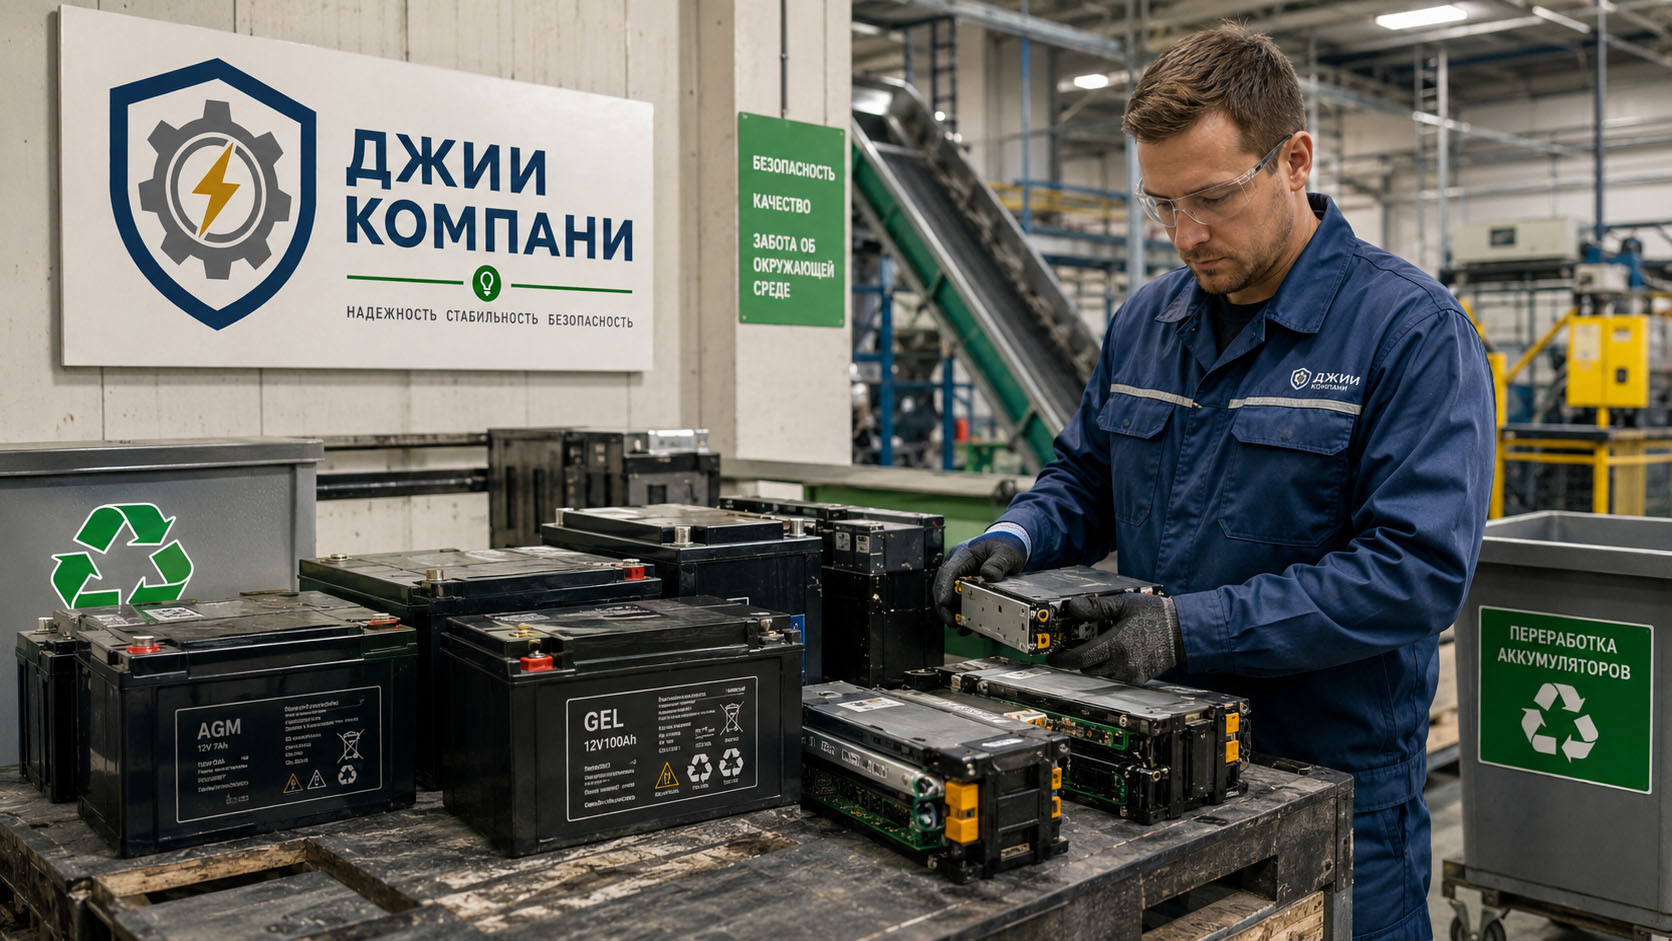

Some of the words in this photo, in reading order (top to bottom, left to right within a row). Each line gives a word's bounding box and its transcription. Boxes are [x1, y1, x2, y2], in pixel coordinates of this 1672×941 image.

[346, 128, 546, 197] ДЖИИ
[752, 155, 836, 181] БЕЗОПАСНОСТЬ
[752, 193, 811, 214] КАЧЕСТВО
[346, 195, 633, 262] КОМПАНИ
[753, 233, 798, 252] ЗАБОТА
[800, 237, 816, 254] ОБ
[753, 257, 835, 280] ОКРУЖАЮЩЕЙ
[753, 280, 791, 299] СРЕДЕ
[346, 306, 437, 321] НАДЕЖНОСТЬ
[446, 309, 539, 325] СТАБИЛЬНОСТЬ
[548, 313, 634, 328] БЕЗОПАСНОСТЬ
[1312, 372, 1361, 386] ДЖИИ
[1509, 625, 1618, 654] ПЕРЕРАБОТКА
[1497, 647, 1631, 680] АККУМУЛЯТОРОВ
[197, 718, 241, 740] AGM
[583, 708, 624, 732] GEL
[198, 743, 212, 752] 12V
[583, 734, 637, 752] 12V100Ah
